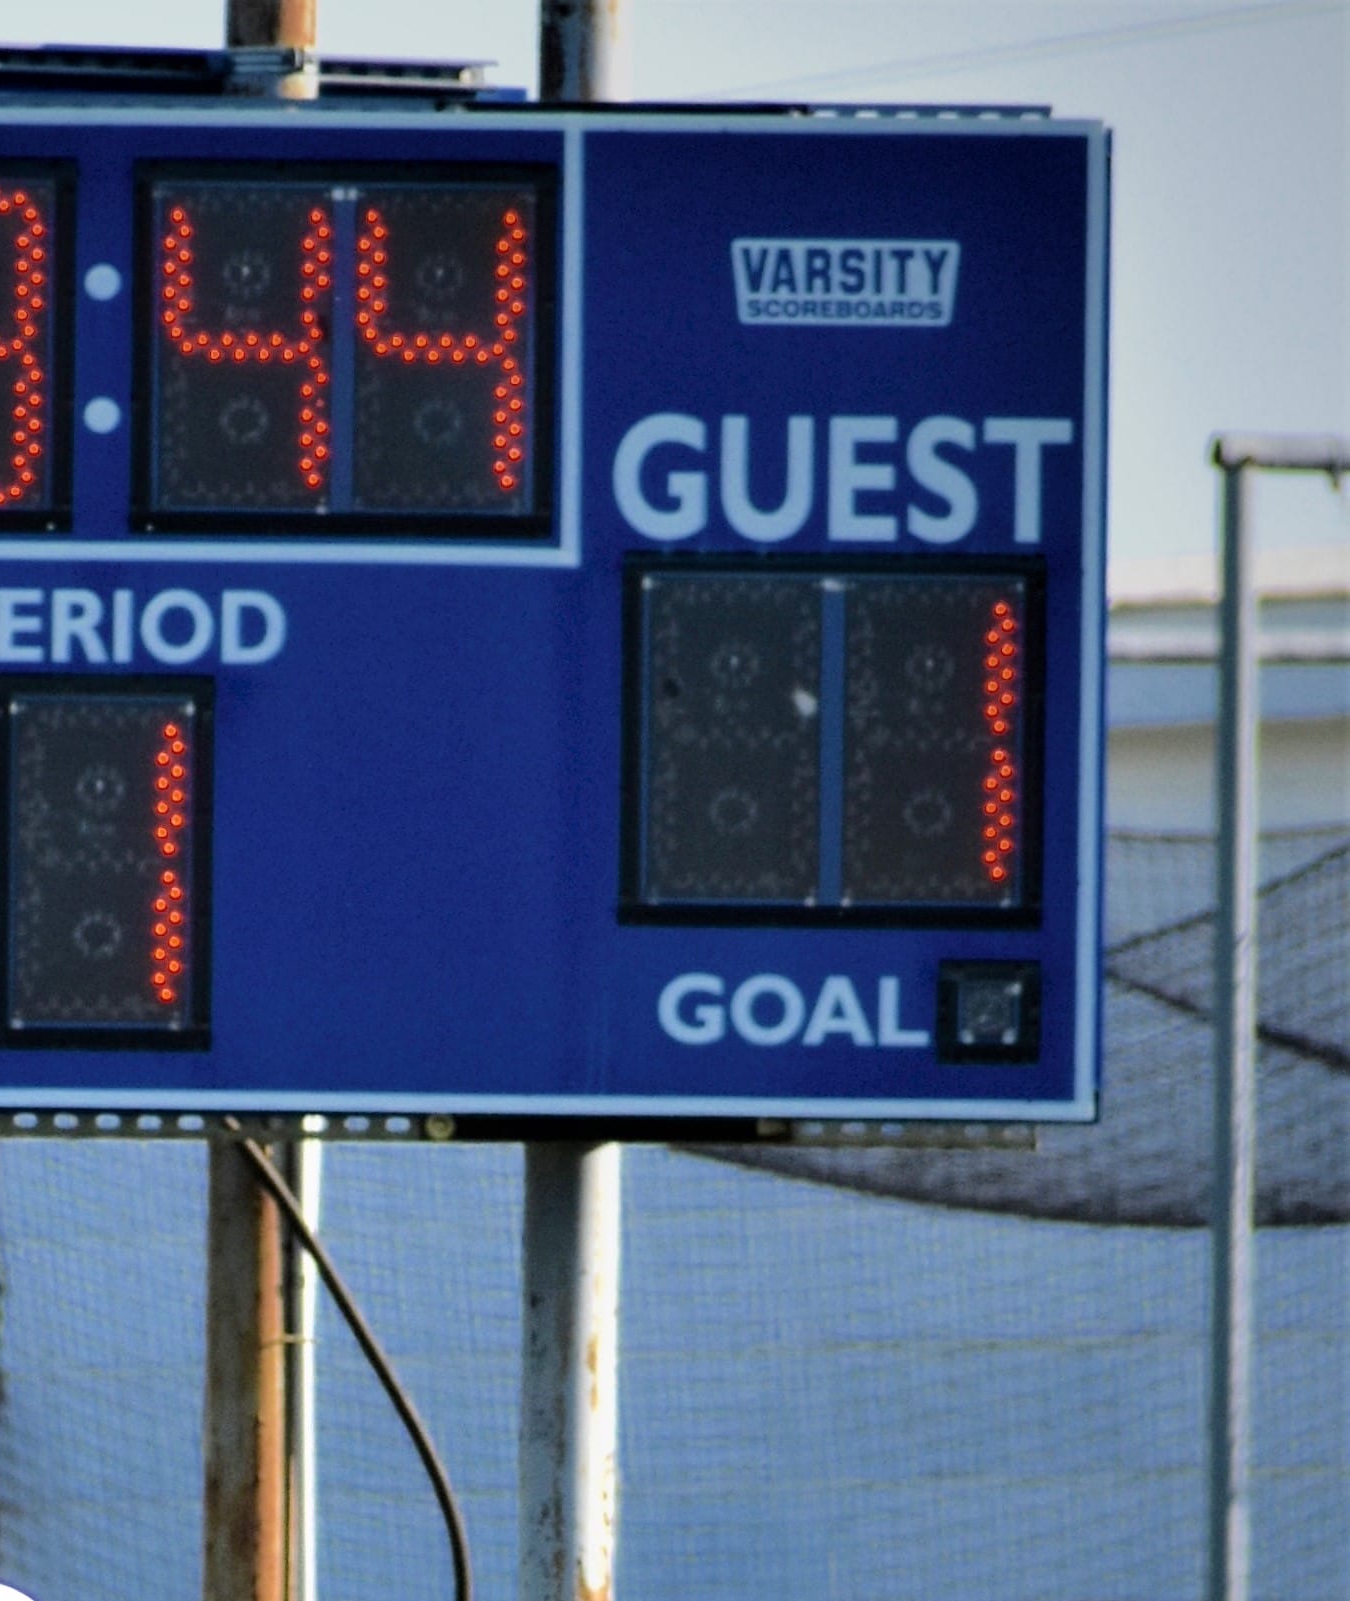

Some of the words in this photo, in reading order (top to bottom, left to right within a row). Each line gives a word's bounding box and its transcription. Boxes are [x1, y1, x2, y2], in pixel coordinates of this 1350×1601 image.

[741, 246, 949, 296] VARSITY
[747, 298, 943, 320] SCOREBOARDS
[612, 413, 1073, 543] GUEST
[981, 600, 1017, 881] 1
[150, 720, 188, 1003] 1
[657, 973, 929, 1047] GOAL
